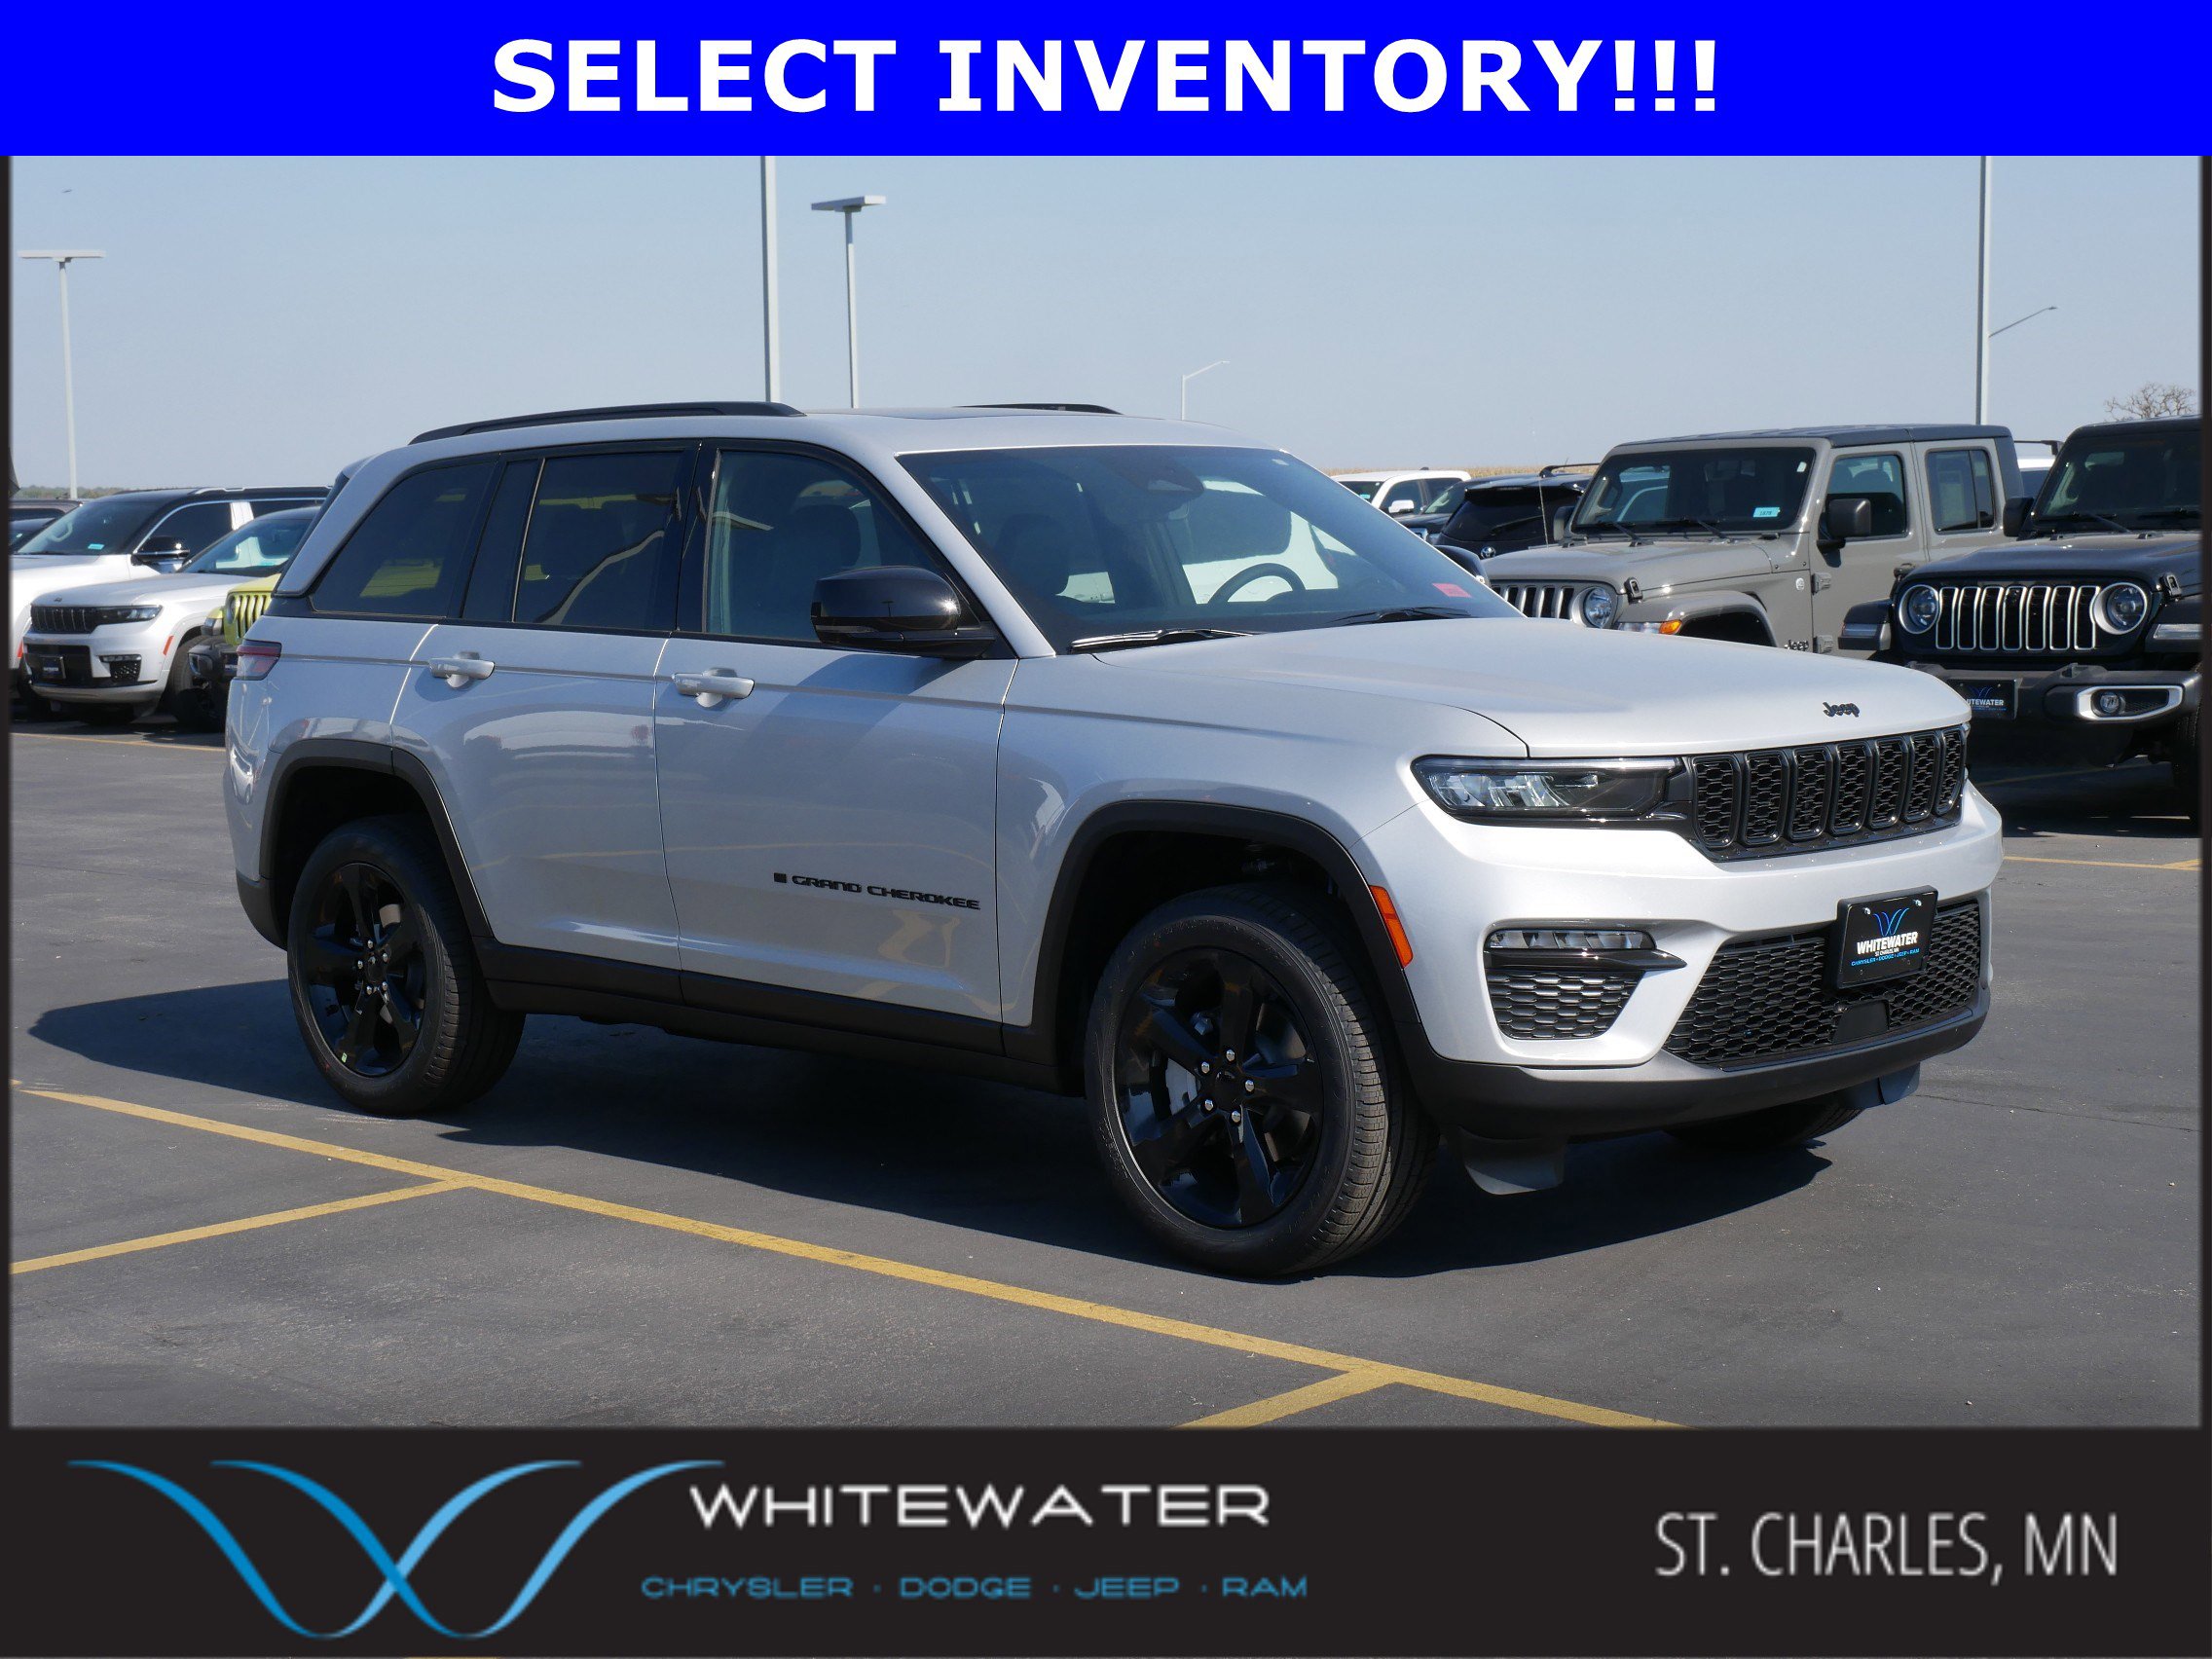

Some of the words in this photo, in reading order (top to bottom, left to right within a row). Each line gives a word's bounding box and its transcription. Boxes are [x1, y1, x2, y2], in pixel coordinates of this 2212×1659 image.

[1823, 701, 1860, 718] Jeep
[792, 874, 862, 893] GRAND
[866, 885, 981, 910] CHEROKEE
[1857, 932, 1918, 954] WHITEWATER
